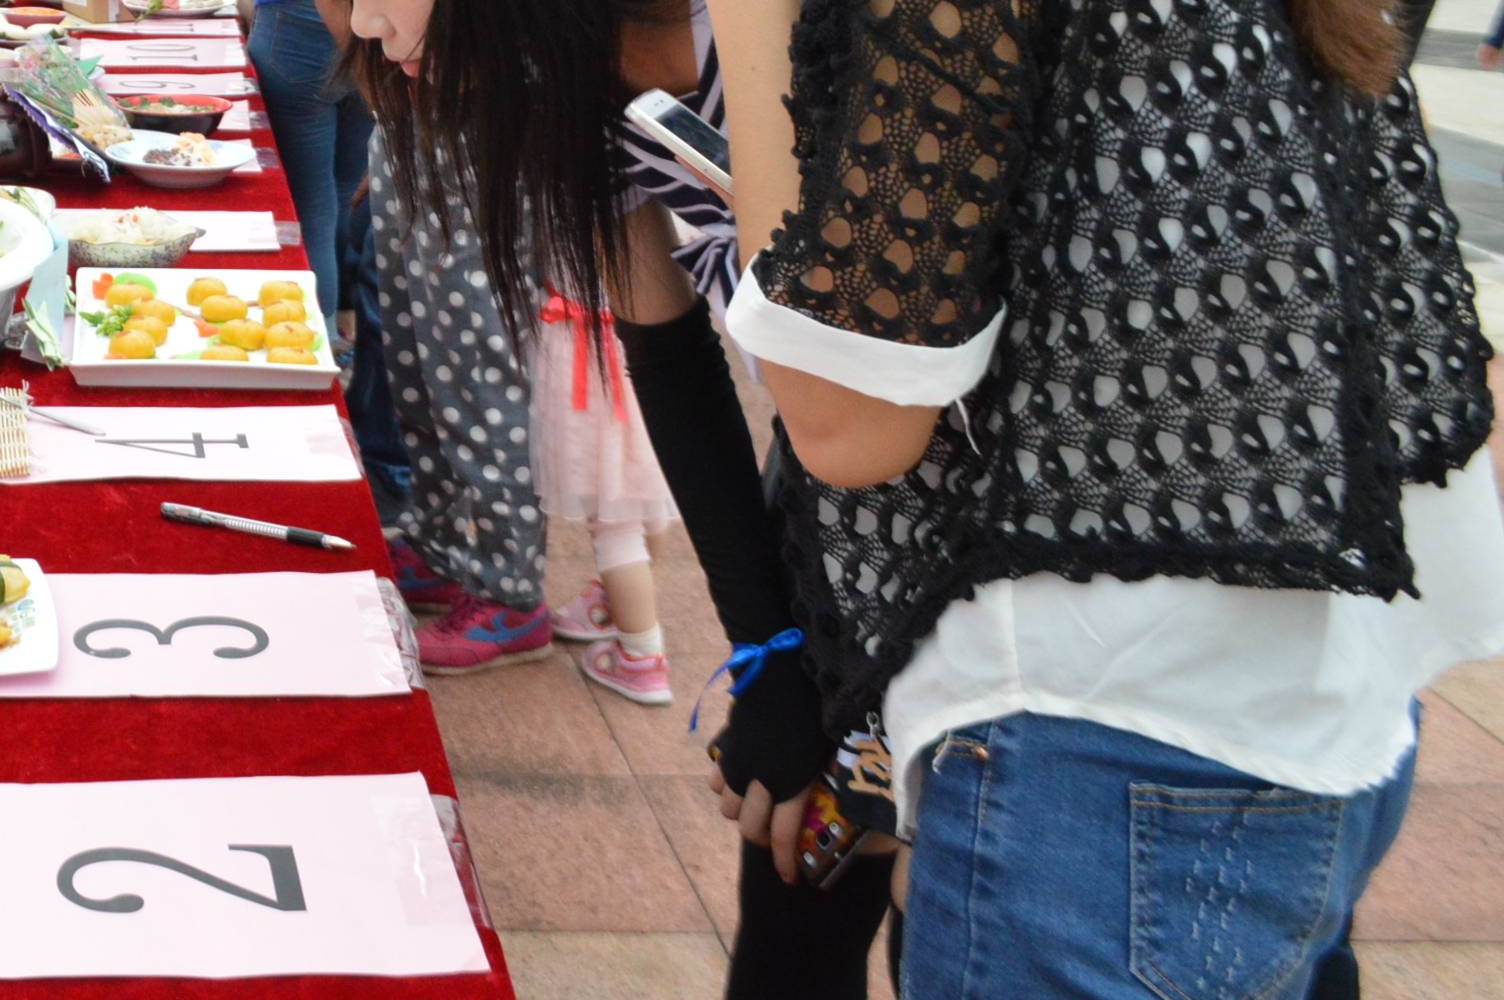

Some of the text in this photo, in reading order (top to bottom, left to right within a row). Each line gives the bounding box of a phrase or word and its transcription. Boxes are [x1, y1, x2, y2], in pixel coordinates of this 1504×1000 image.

[127, 43, 198, 61] 10
[95, 432, 248, 458] 4
[74, 616, 269, 659] 3
[57, 844, 307, 913] 2
